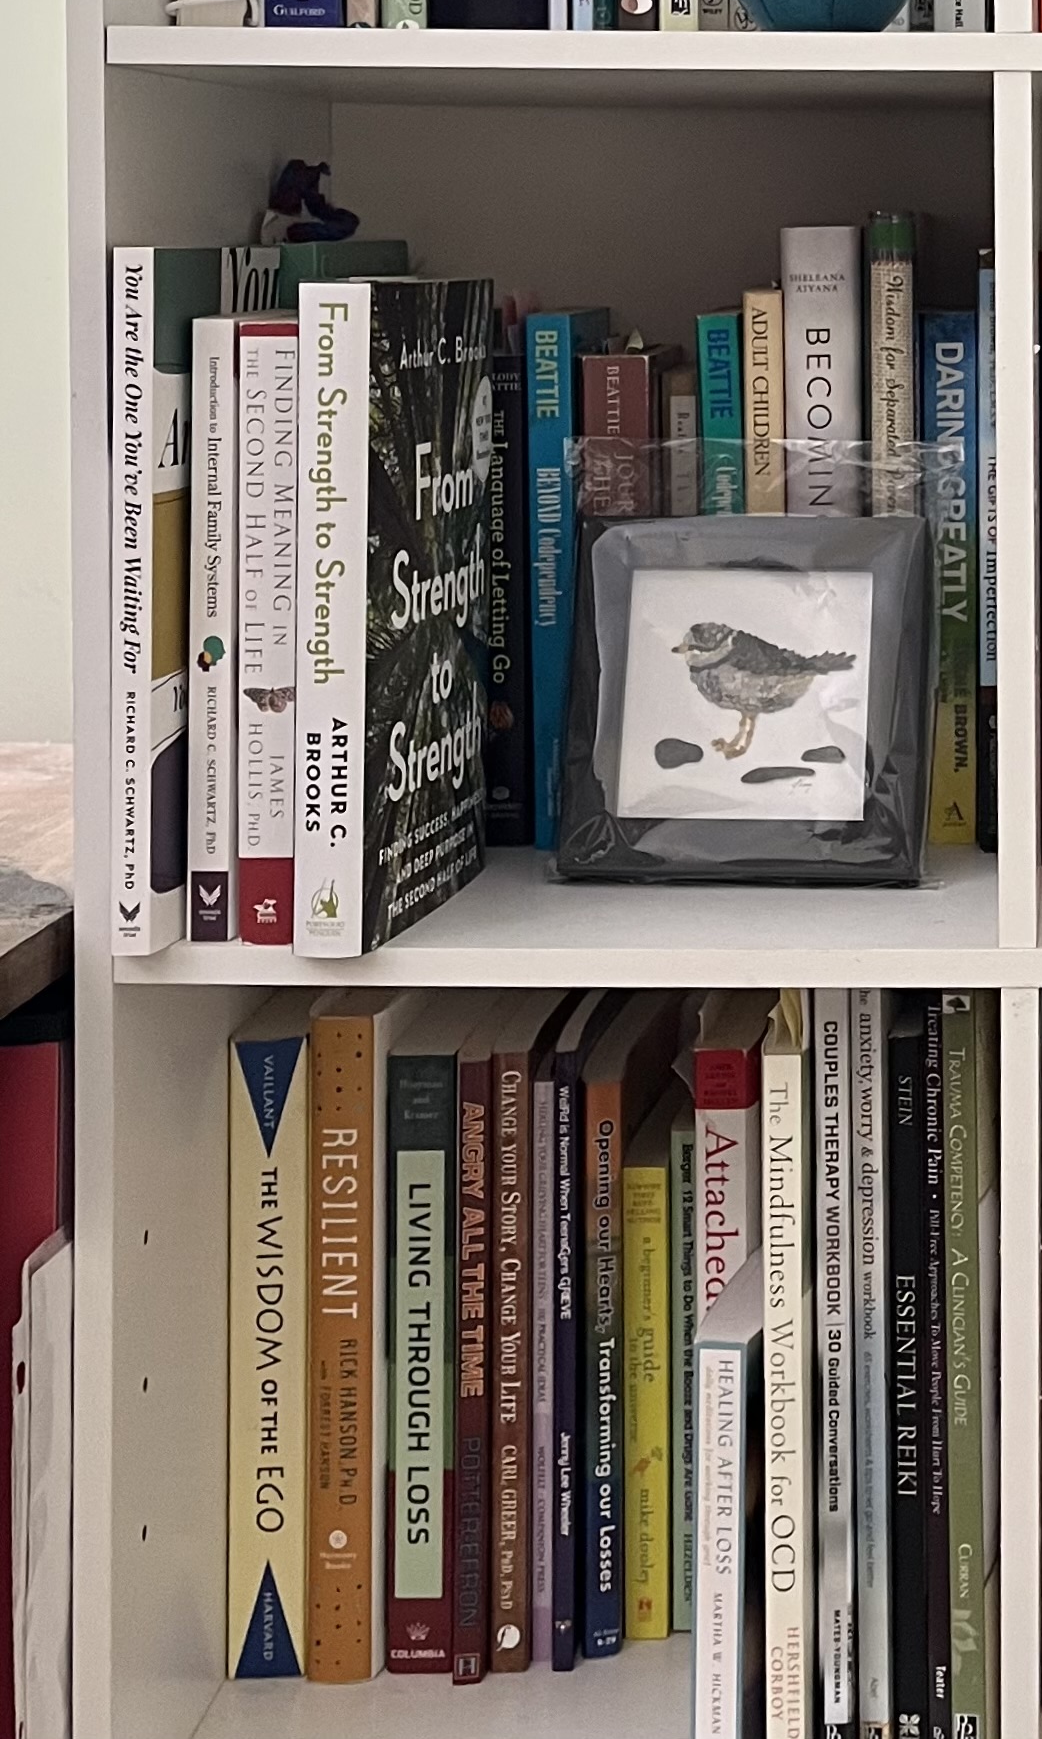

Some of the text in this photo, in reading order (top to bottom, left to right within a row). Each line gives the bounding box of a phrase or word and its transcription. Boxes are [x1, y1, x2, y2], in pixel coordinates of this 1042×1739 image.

[125, 265, 143, 299] You
[125, 306, 142, 341] Are
[125, 346, 144, 376] the
[125, 384, 142, 423] One
[535, 330, 560, 418] BEATTIE
[751, 307, 771, 476] ADULT CHILDREN
[124, 501, 142, 550] Been
[307, 303, 348, 684] From Strength to Strength
[119, 558, 141, 635] Waiting
[123, 639, 141, 674] For
[306, 732, 320, 832] BROOKS
[330, 718, 347, 847] ARTHUR C.
[263, 1054, 275, 1129] VAILLANT
[321, 1129, 357, 1319] RESILIENT
[255, 1167, 284, 1533] THE WISDOM OF THE EGO
[408, 1183, 431, 1545] LIVING THROUGH LOSS
[769, 1082, 795, 1593] The Mindfulness Workbook for OCD
[263, 1592, 274, 1661] HARVARD
